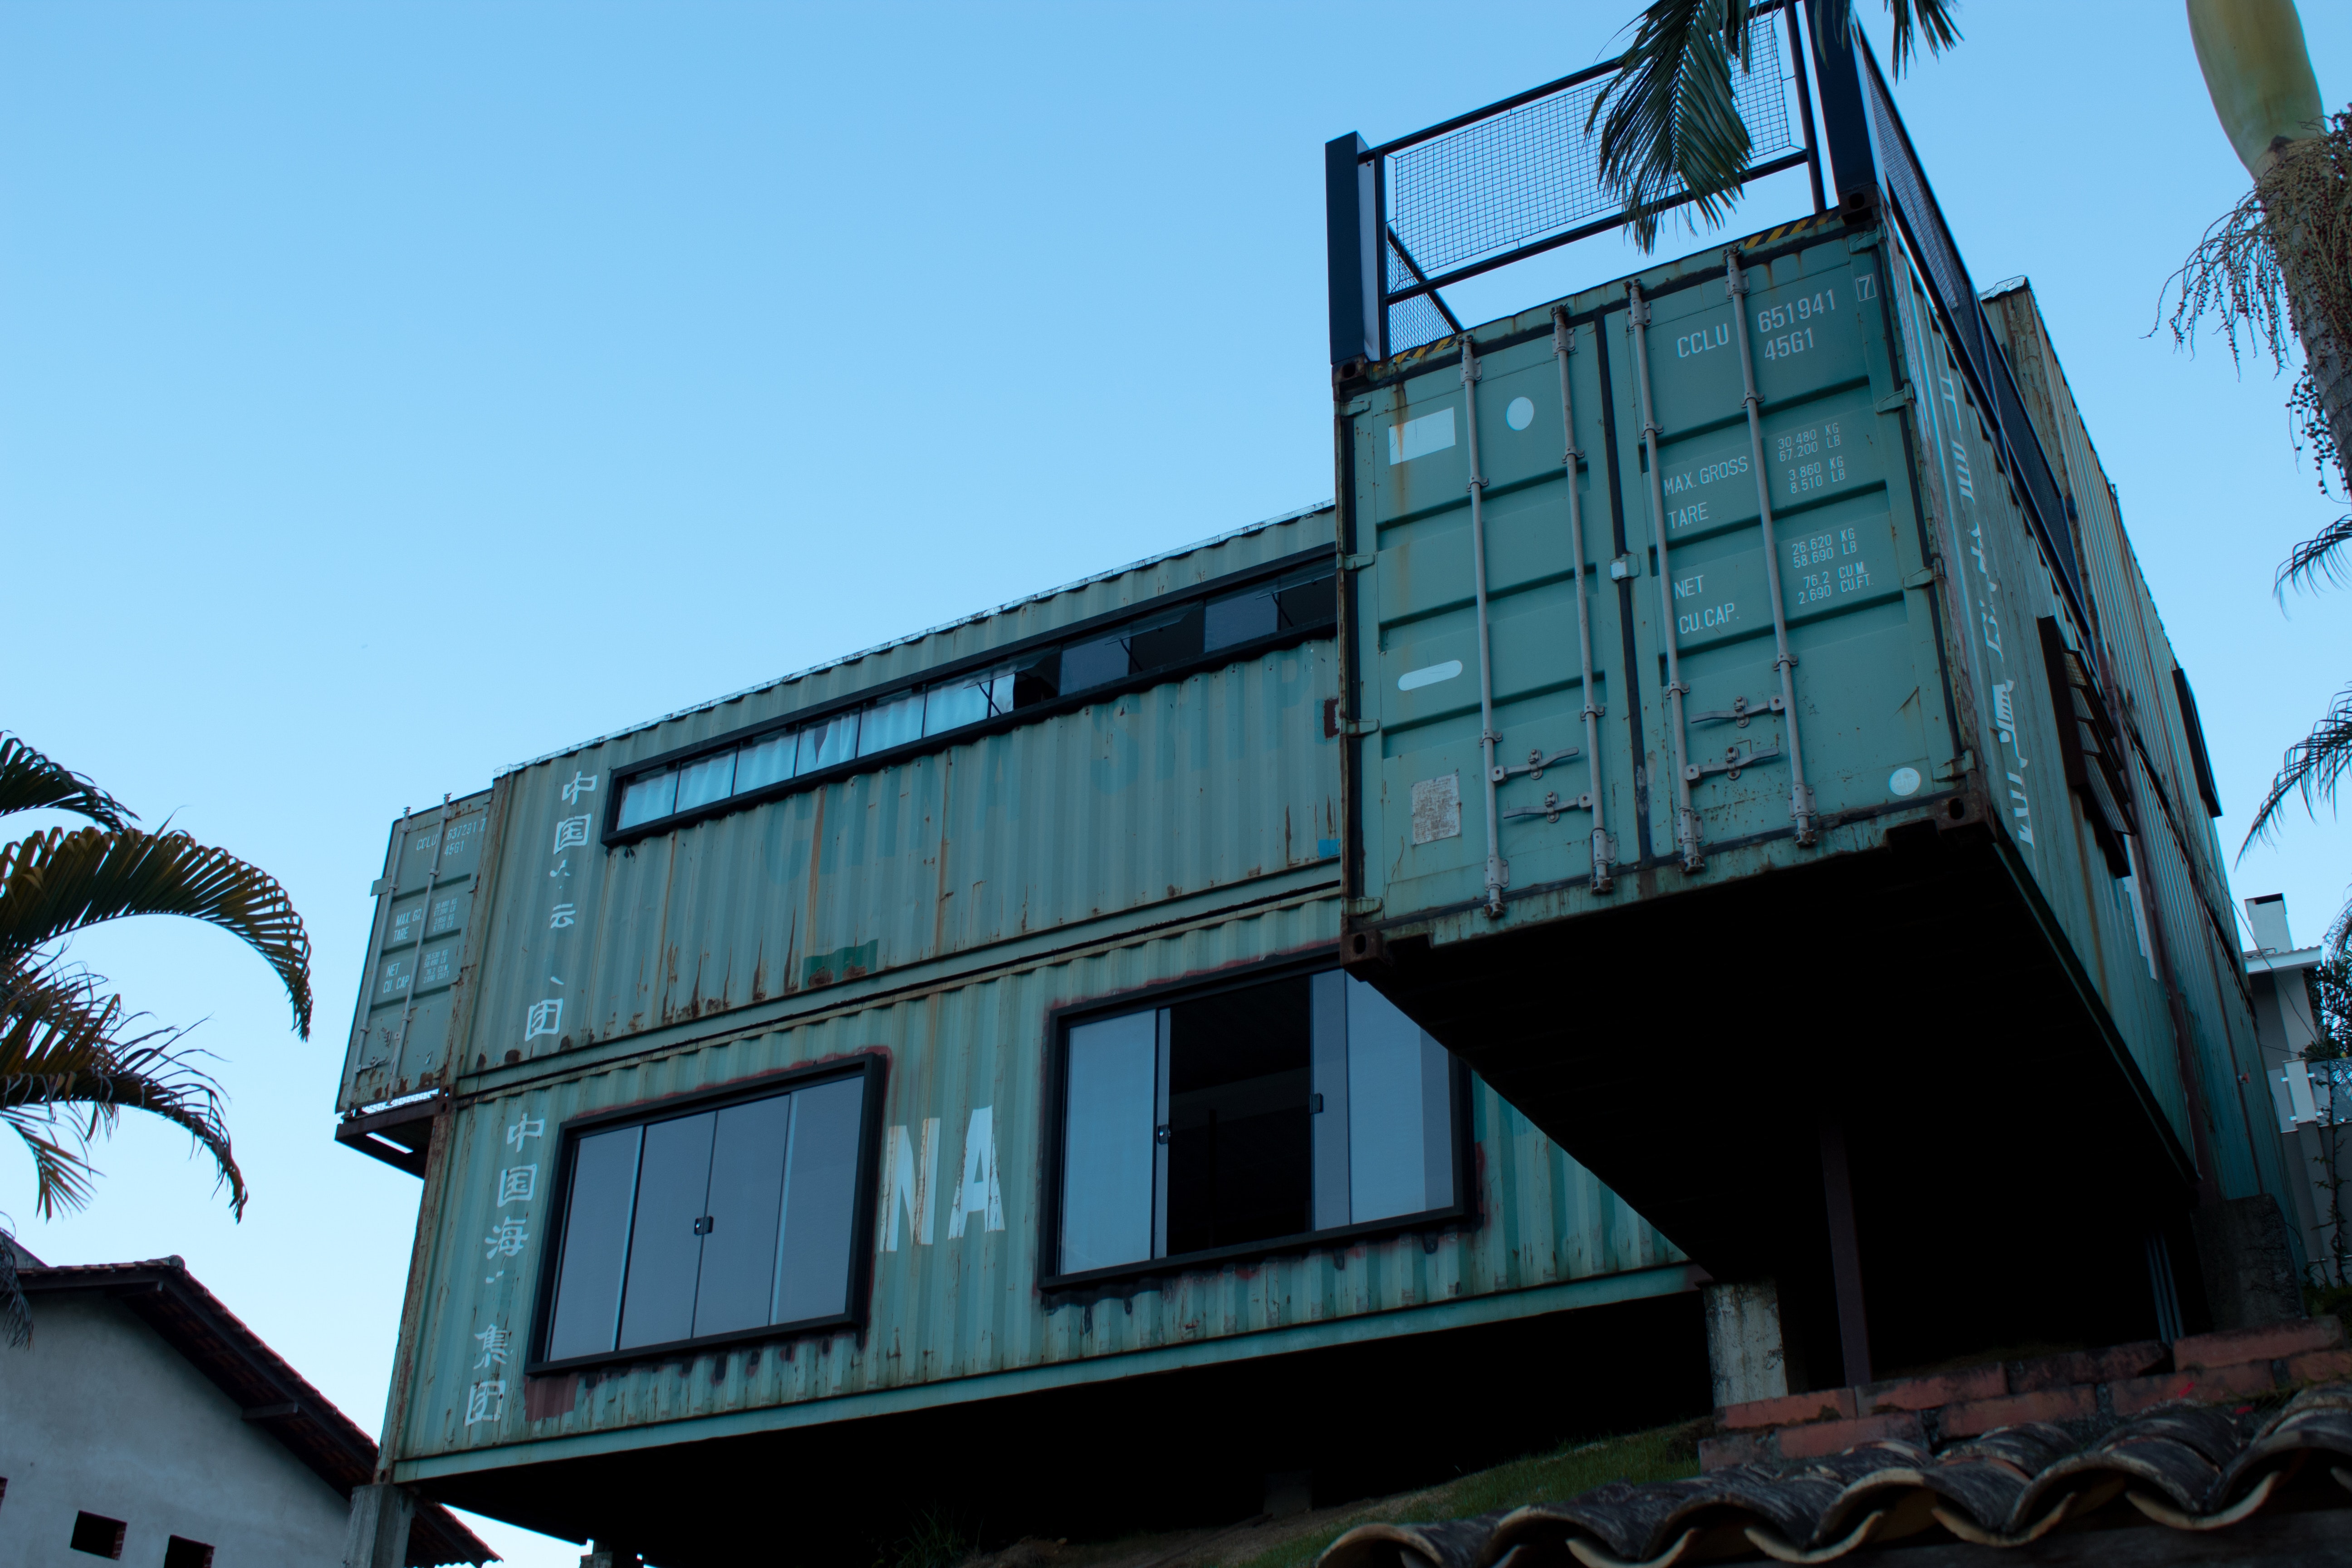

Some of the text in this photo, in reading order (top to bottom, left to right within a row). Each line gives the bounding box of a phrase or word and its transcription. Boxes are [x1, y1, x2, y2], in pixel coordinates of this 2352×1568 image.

[1677, 323, 1729, 358] CCLU
[1757, 289, 1836, 333] 651941
[1764, 328, 1814, 361] 45G1
[1778, 422, 1839, 450] 30.480 KG
[1779, 435, 1841, 462] 67.200 LB
[1663, 456, 1749, 496] MAX. GROSS
[1788, 456, 1844, 481] 3.860 KG
[1790, 468, 1845, 494] 8.510 LB
[1667, 502, 1709, 529] TARE
[1791, 527, 1855, 556] 26.620 KG
[1793, 540, 1857, 568] 58.690 LB
[1674, 575, 1704, 599] NET
[1803, 571, 1829, 588] 76.2
[1798, 584, 1832, 604] 2.690
[416, 834, 438, 851] CCLU
[447, 821, 477, 840] 637291
[444, 840, 465, 856] 45G1
[394, 926, 409, 942] TARE
[386, 962, 401, 978] NET
[879, 1105, 1005, 1252] NA
[465, 1113, 545, 1426] 中国海集团
